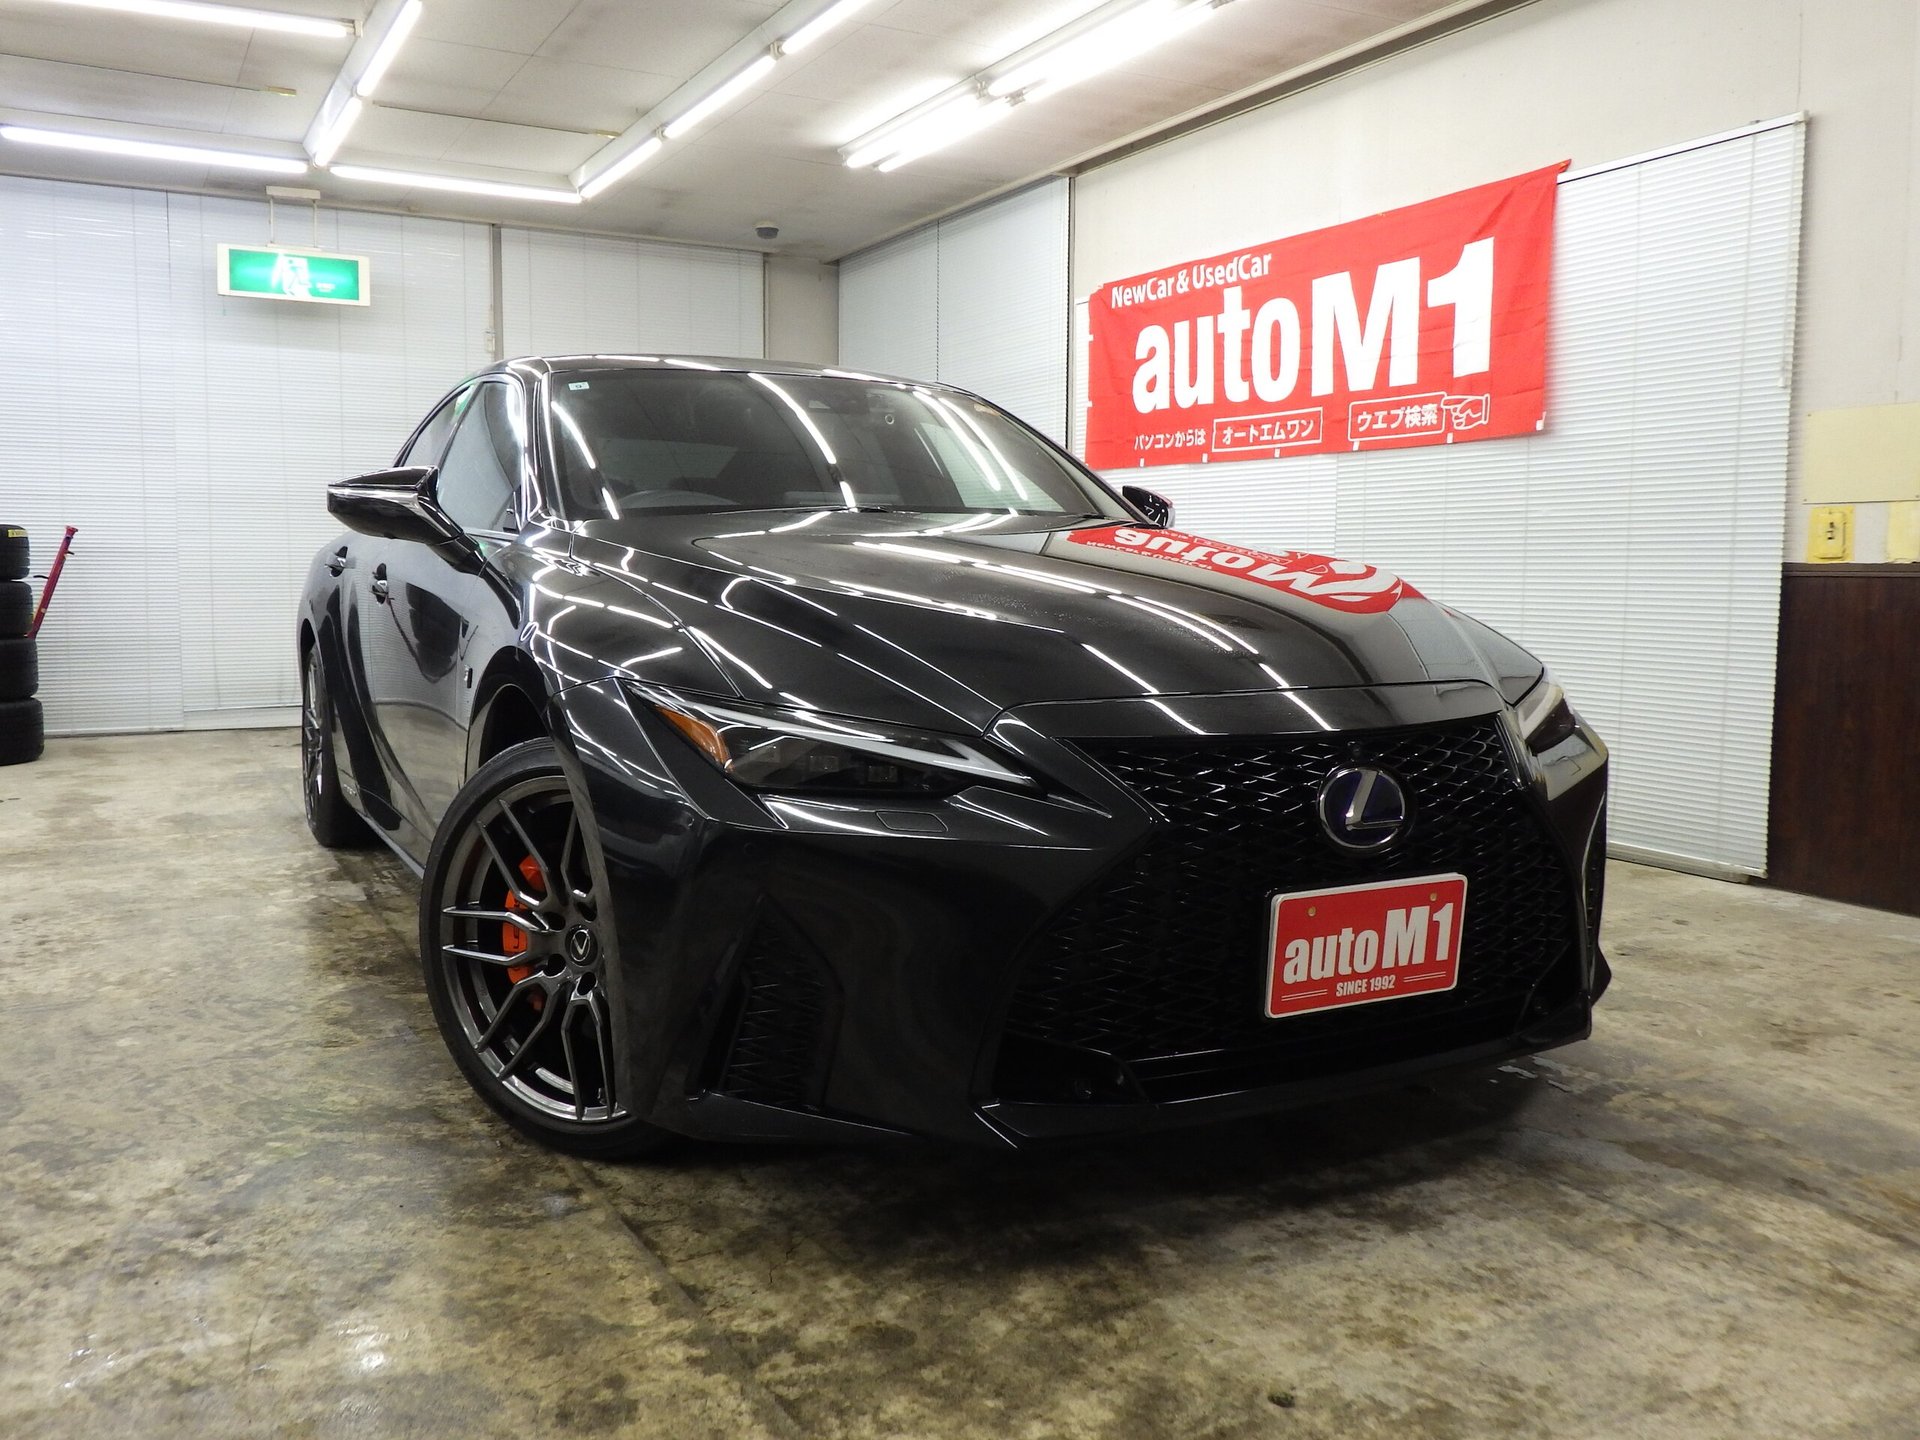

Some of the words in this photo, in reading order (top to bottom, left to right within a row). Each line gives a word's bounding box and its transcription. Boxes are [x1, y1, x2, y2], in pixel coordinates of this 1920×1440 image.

[1111, 276, 1174, 309] NewCar
[1176, 269, 1190, 294] &
[1192, 253, 1272, 290] UsedCar
[1222, 419, 1314, 445] オートエムワン
[1335, 978, 1368, 997] SINCE
[1369, 974, 1396, 992] 1992
